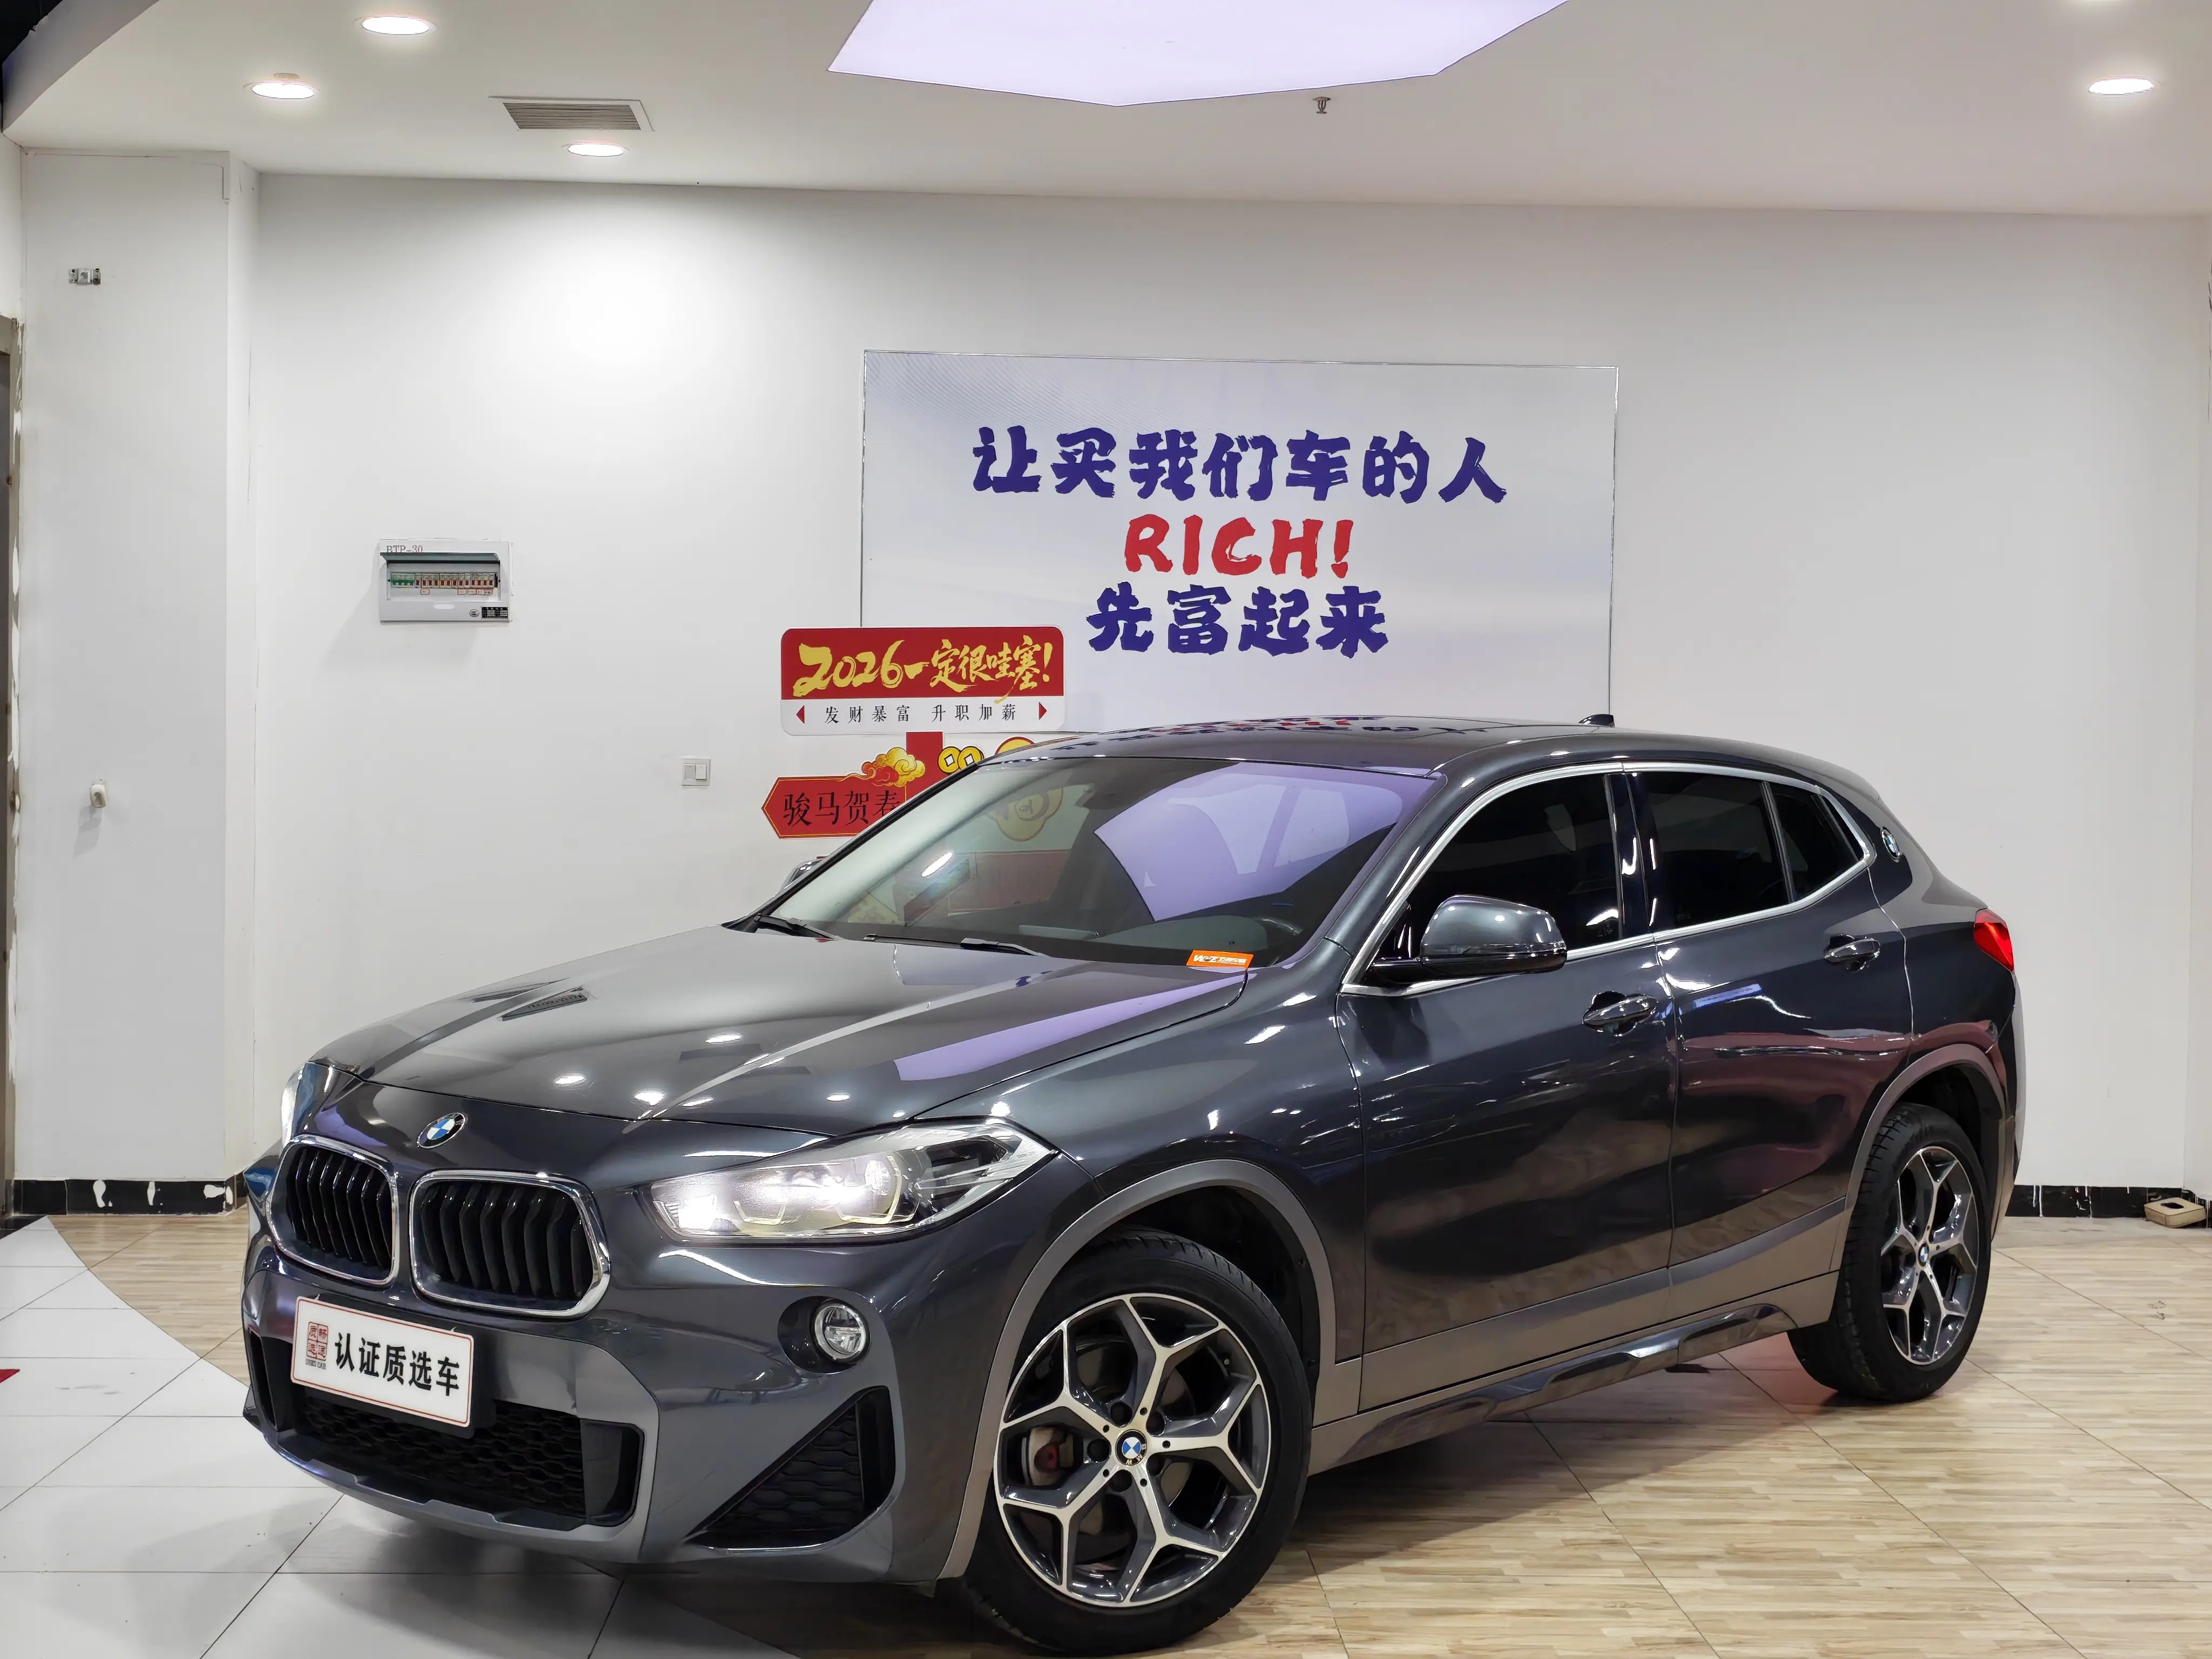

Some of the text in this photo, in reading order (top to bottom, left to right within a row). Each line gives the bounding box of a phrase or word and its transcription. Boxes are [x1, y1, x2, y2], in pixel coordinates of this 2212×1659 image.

[972, 424, 1508, 504] 让买我们车的人
[1123, 513, 1354, 579] RICH!
[1086, 581, 1388, 659] 先富起来
[825, 703, 1017, 724] 发财暴富 升职加薪
[334, 1332, 460, 1397] 认证质选车
[1125, 1444, 1147, 1466] BMW
